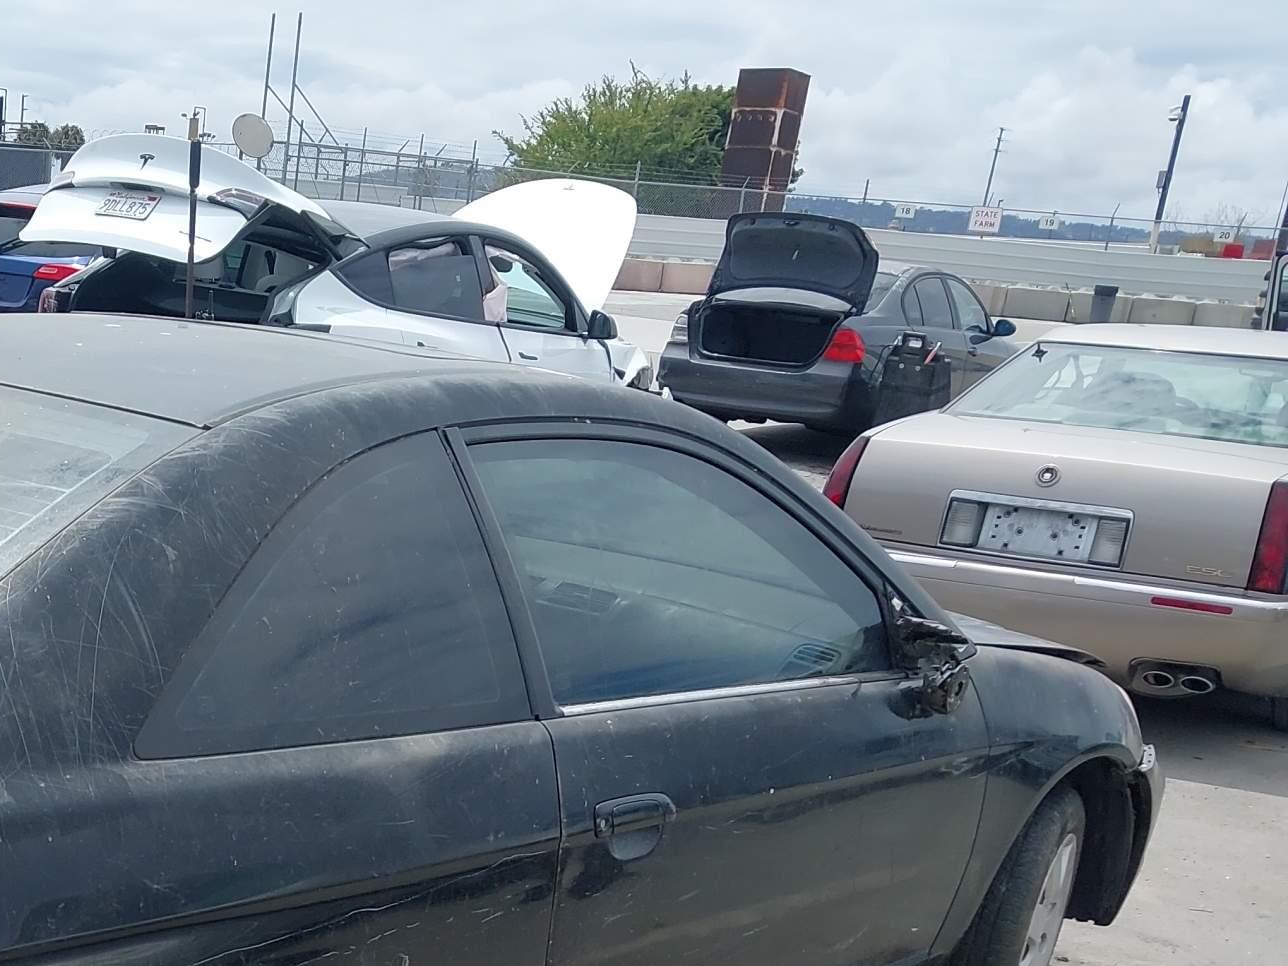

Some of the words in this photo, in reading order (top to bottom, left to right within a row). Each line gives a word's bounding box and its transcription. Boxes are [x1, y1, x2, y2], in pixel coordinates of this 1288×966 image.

[99, 198, 150, 214] 9DLL875
[901, 207, 911, 215] 18
[975, 210, 999, 219] STATE
[974, 220, 995, 228] FARM
[1045, 218, 1055, 227] 19
[1219, 231, 1231, 240] 20
